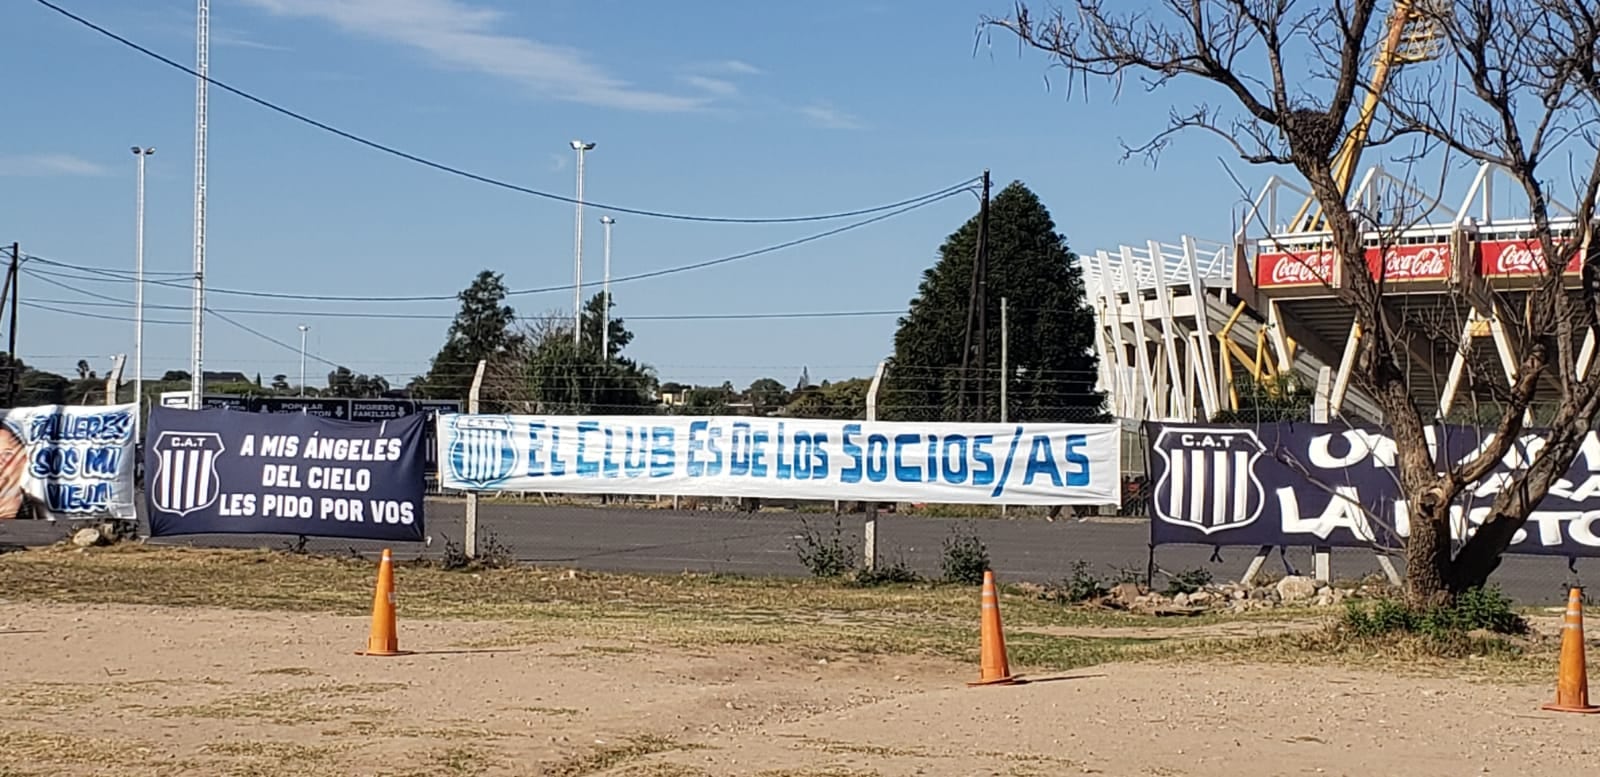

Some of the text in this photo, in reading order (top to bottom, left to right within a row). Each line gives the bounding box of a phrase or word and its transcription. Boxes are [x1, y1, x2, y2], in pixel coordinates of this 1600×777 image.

[352, 410, 397, 418] FAMILIAS
[354, 403, 396, 411] INGRESO
[30, 412, 130, 442] TALLERES
[34, 447, 119, 475] SOS MI
[240, 431, 402, 462] A MIS ÁNGELES
[527, 420, 1091, 497] EL CLUB ES DE LOS SOCIOS/AS
[262, 464, 371, 492] DEL CIELO
[219, 494, 414, 525] LES PIDO POR VOS
[1276, 486, 1377, 542] LA
